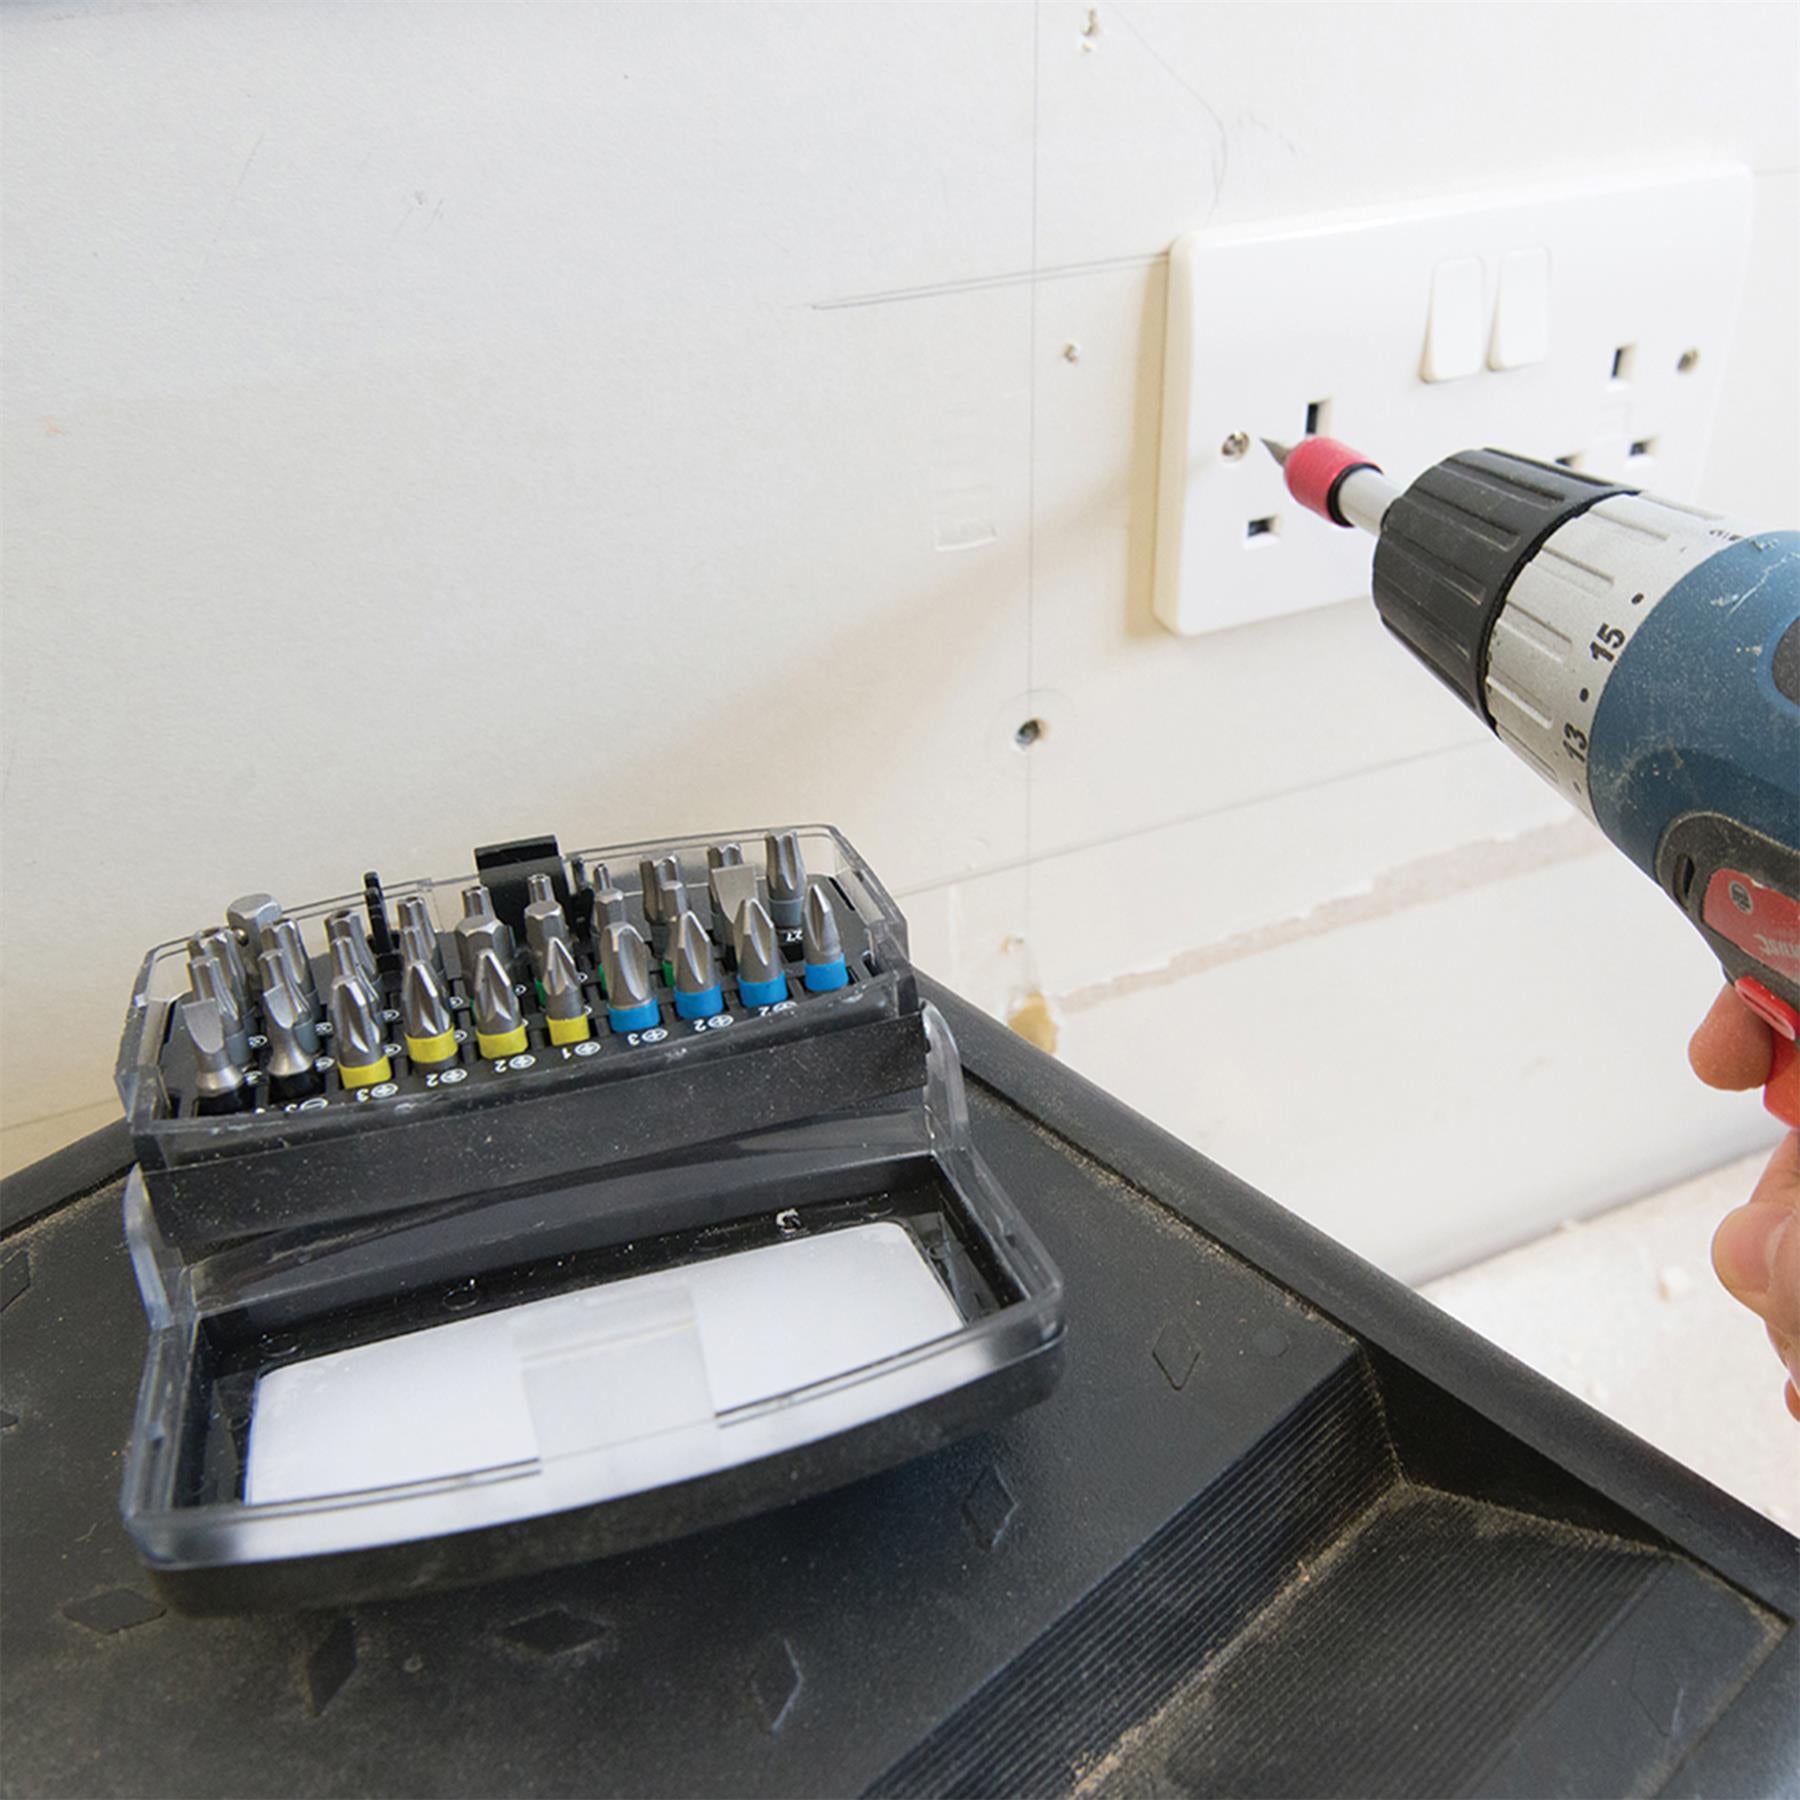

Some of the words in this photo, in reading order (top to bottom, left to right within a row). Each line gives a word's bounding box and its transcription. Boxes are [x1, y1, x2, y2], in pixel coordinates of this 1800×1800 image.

[1589, 623, 1626, 663] 15
[1562, 722, 1588, 763] 13
[693, 1019, 706, 1032] 2
[627, 1033, 640, 1046] 3
[561, 1048, 572, 1060] 1
[494, 1059, 507, 1073] 2
[426, 1073, 439, 1087] 2
[356, 1088, 370, 1102] 3
